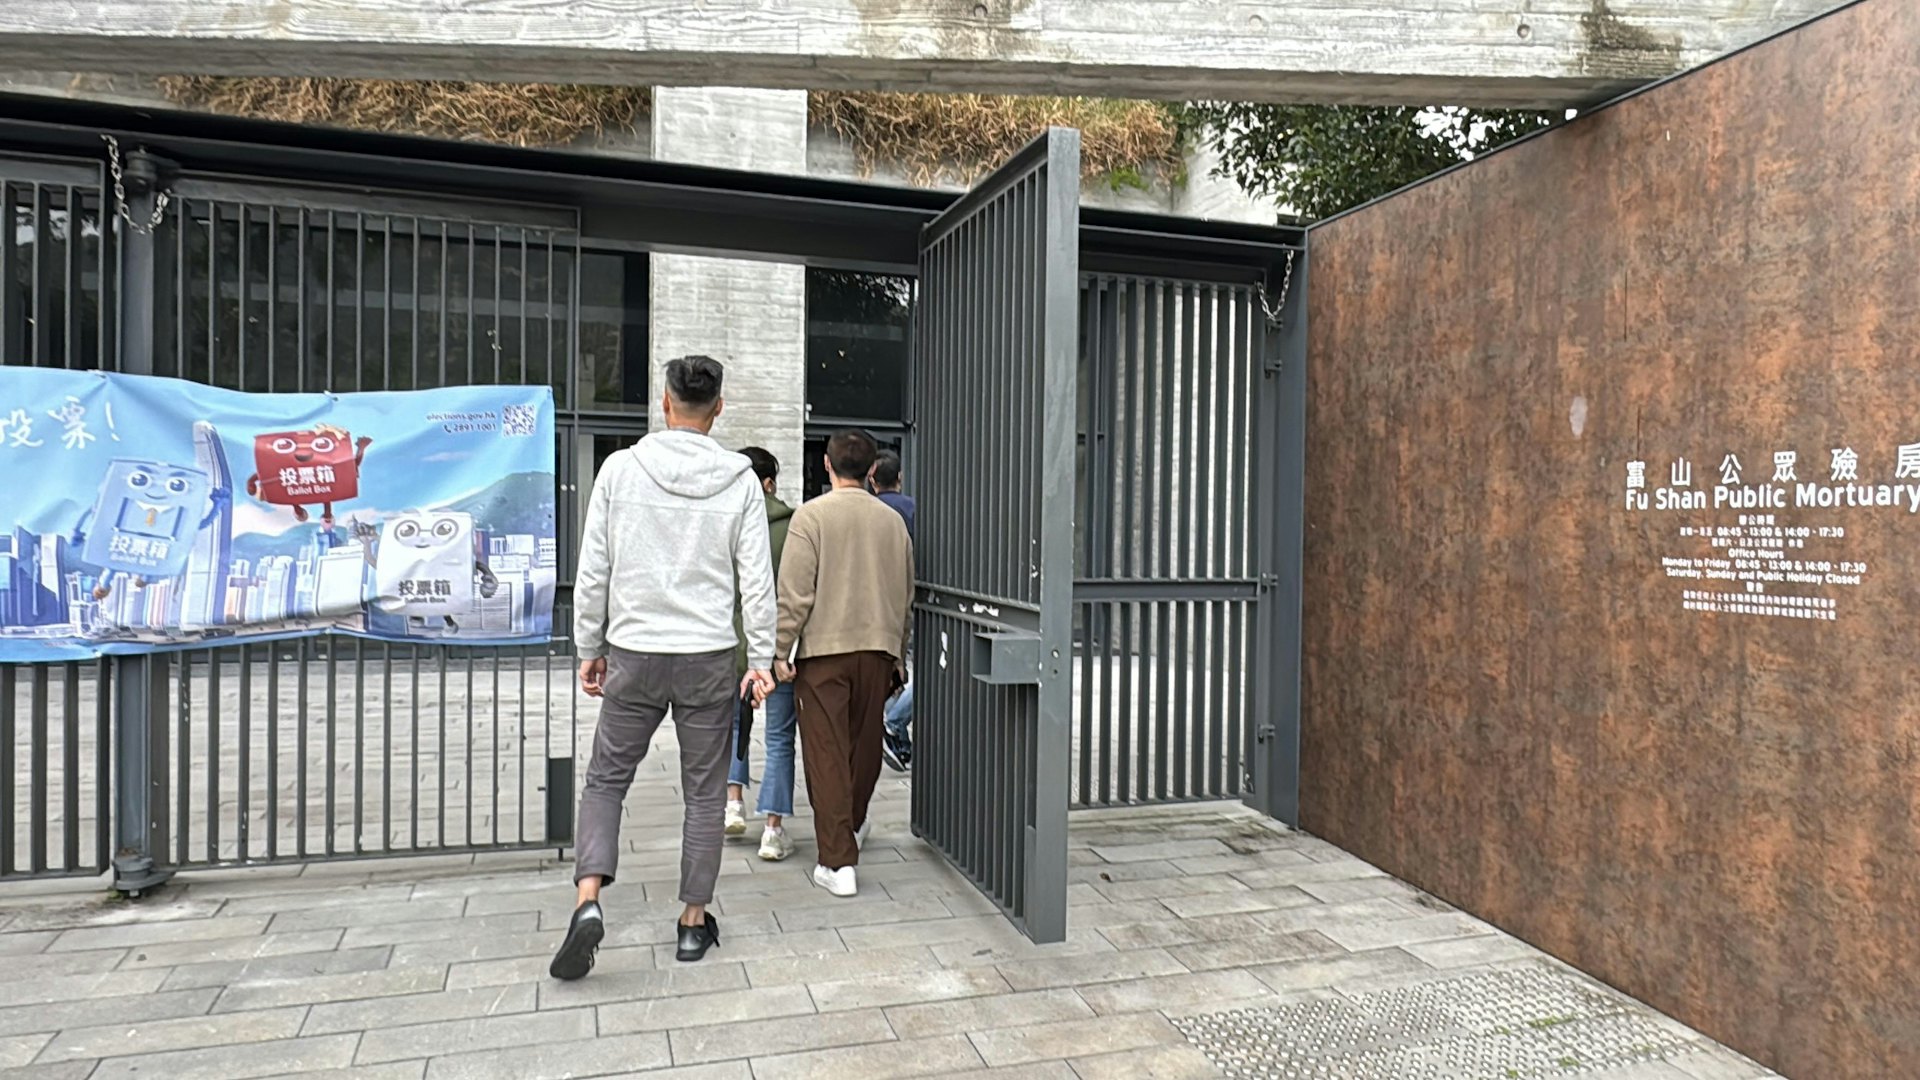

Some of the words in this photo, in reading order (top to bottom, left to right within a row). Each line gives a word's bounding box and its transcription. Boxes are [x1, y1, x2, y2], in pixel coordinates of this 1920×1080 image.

[1626, 443, 1920, 488] 富山公眾殮房
[279, 464, 336, 487] 投票箱
[286, 486, 313, 496] Ballot
[314, 485, 332, 494] Box
[1626, 489, 1649, 510] Fu
[1655, 487, 1706, 510] Shan
[1714, 484, 1787, 509] Public
[1795, 482, 1920, 513] Mortuary
[1717, 526, 1742, 537] 08:45
[1749, 526, 1773, 537] 13:00
[1774, 527, 1782, 537] &
[1785, 527, 1810, 538] 14:00
[1818, 527, 1844, 538] 17:30
[109, 535, 169, 560] 投票箱
[1728, 548, 1756, 558] Office
[1758, 549, 1784, 559] Hours
[1662, 556, 1692, 568] Monday
[1694, 558, 1703, 567] to
[1704, 557, 1731, 569] Friday
[1735, 559, 1760, 569] 08:45
[1768, 560, 1792, 571] 13:00
[1794, 560, 1803, 571] &
[1805, 561, 1831, 572] 14:00
[1840, 561, 1867, 573] 17:30
[1706, 568, 1736, 581] Sunday
[1738, 570, 1754, 580] and
[1756, 571, 1784, 582] Public
[1786, 572, 1823, 585] Holiday
[1825, 573, 1860, 585] Closed
[398, 579, 452, 596] 投票箱
